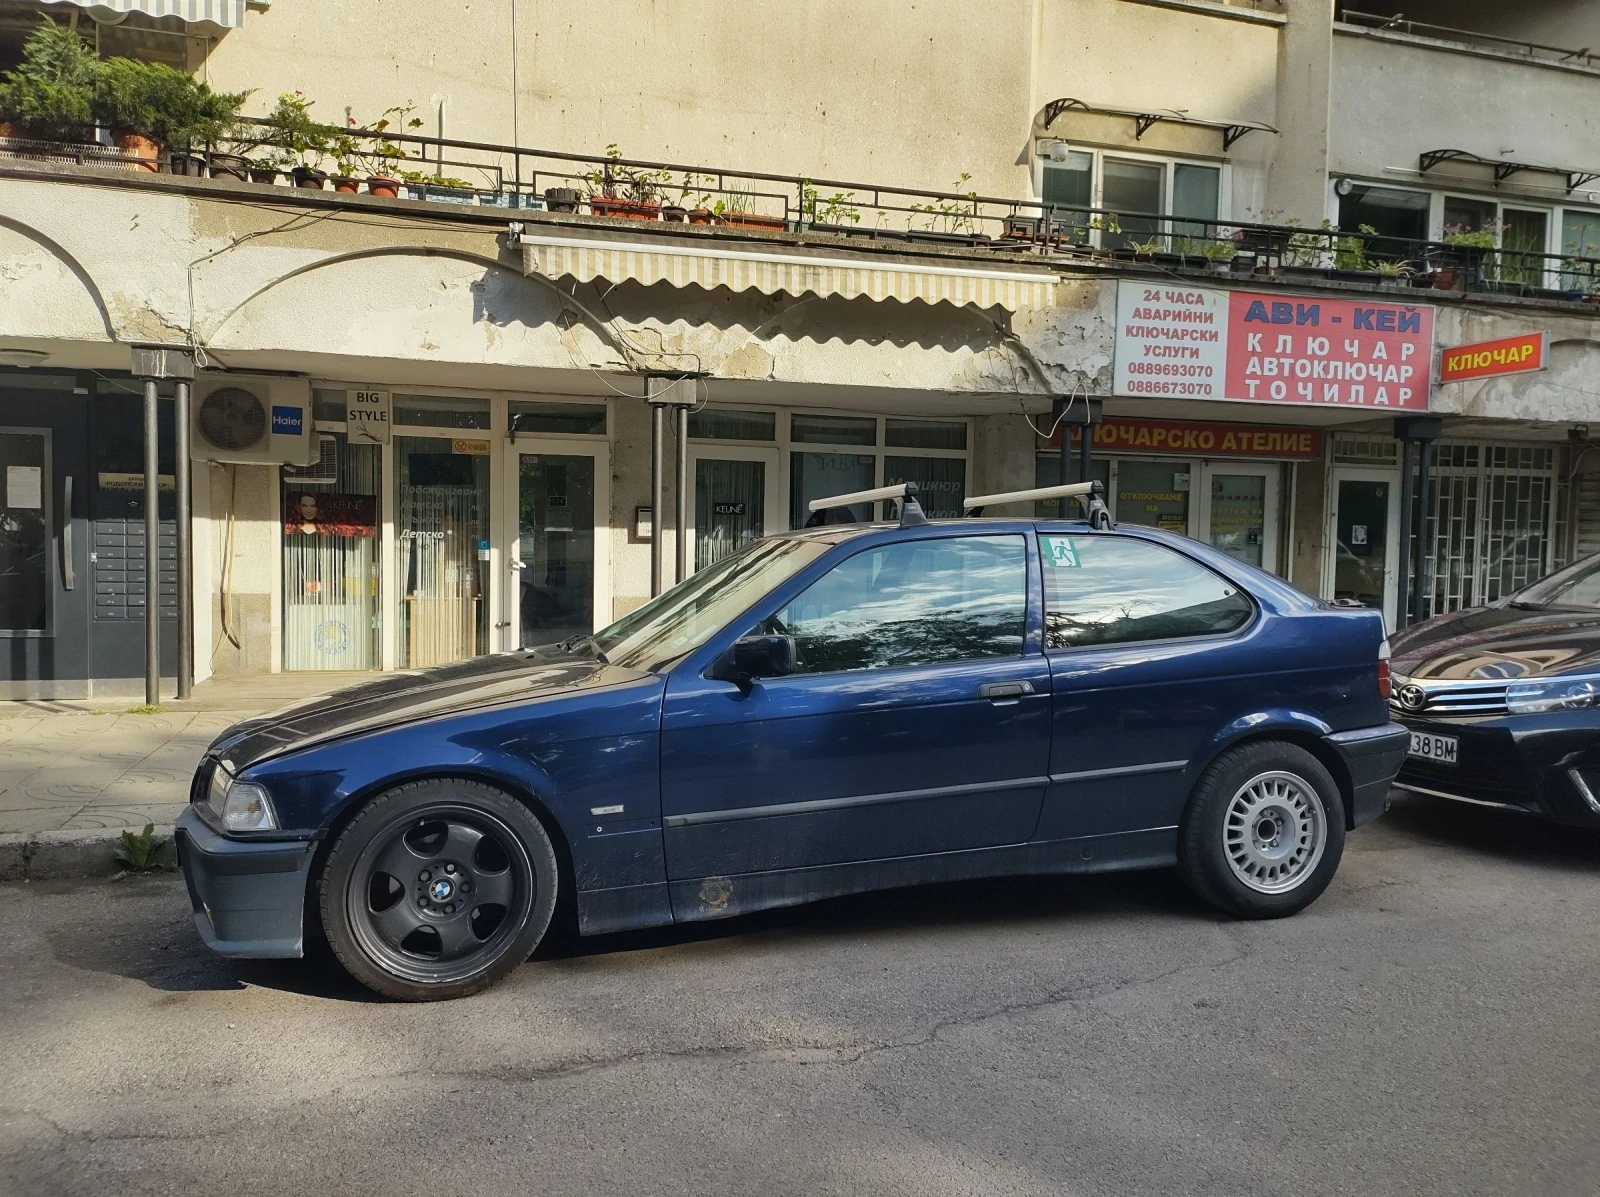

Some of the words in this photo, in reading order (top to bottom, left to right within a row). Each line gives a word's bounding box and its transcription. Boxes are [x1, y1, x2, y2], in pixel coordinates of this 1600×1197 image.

[1143, 289, 1161, 302] 24
[1165, 291, 1205, 305] ЧАСА
[1132, 307, 1214, 324] АВАРИЙНИ
[1244, 300, 1320, 326] АВИ
[1353, 306, 1421, 334] КЕЙ
[1125, 325, 1219, 342] КЛЮЧАРСКИ
[1143, 344, 1200, 359] УСЛУГИ
[1247, 332, 1416, 361] КЛЮЧАР
[1447, 343, 1534, 373] КЛЮЧАР
[1128, 361, 1213, 377] 0889693070
[1245, 356, 1414, 384] АВТОКЛЮЧАР
[1127, 380, 1213, 396] 0886673070
[1245, 379, 1413, 406] ТОЧИЛАР
[357, 392, 379, 403] BIG
[272, 415, 302, 426] Haier
[349, 410, 387, 421] STYLE
[1071, 423, 1215, 450] ЮЧАРСКО
[1221, 431, 1312, 452] АТЕЛИЕ
[1120, 492, 1182, 501] ОТКЛЮЧВАНЕ
[716, 503, 744, 514] KEUNE
[400, 528, 444, 540] Детско
